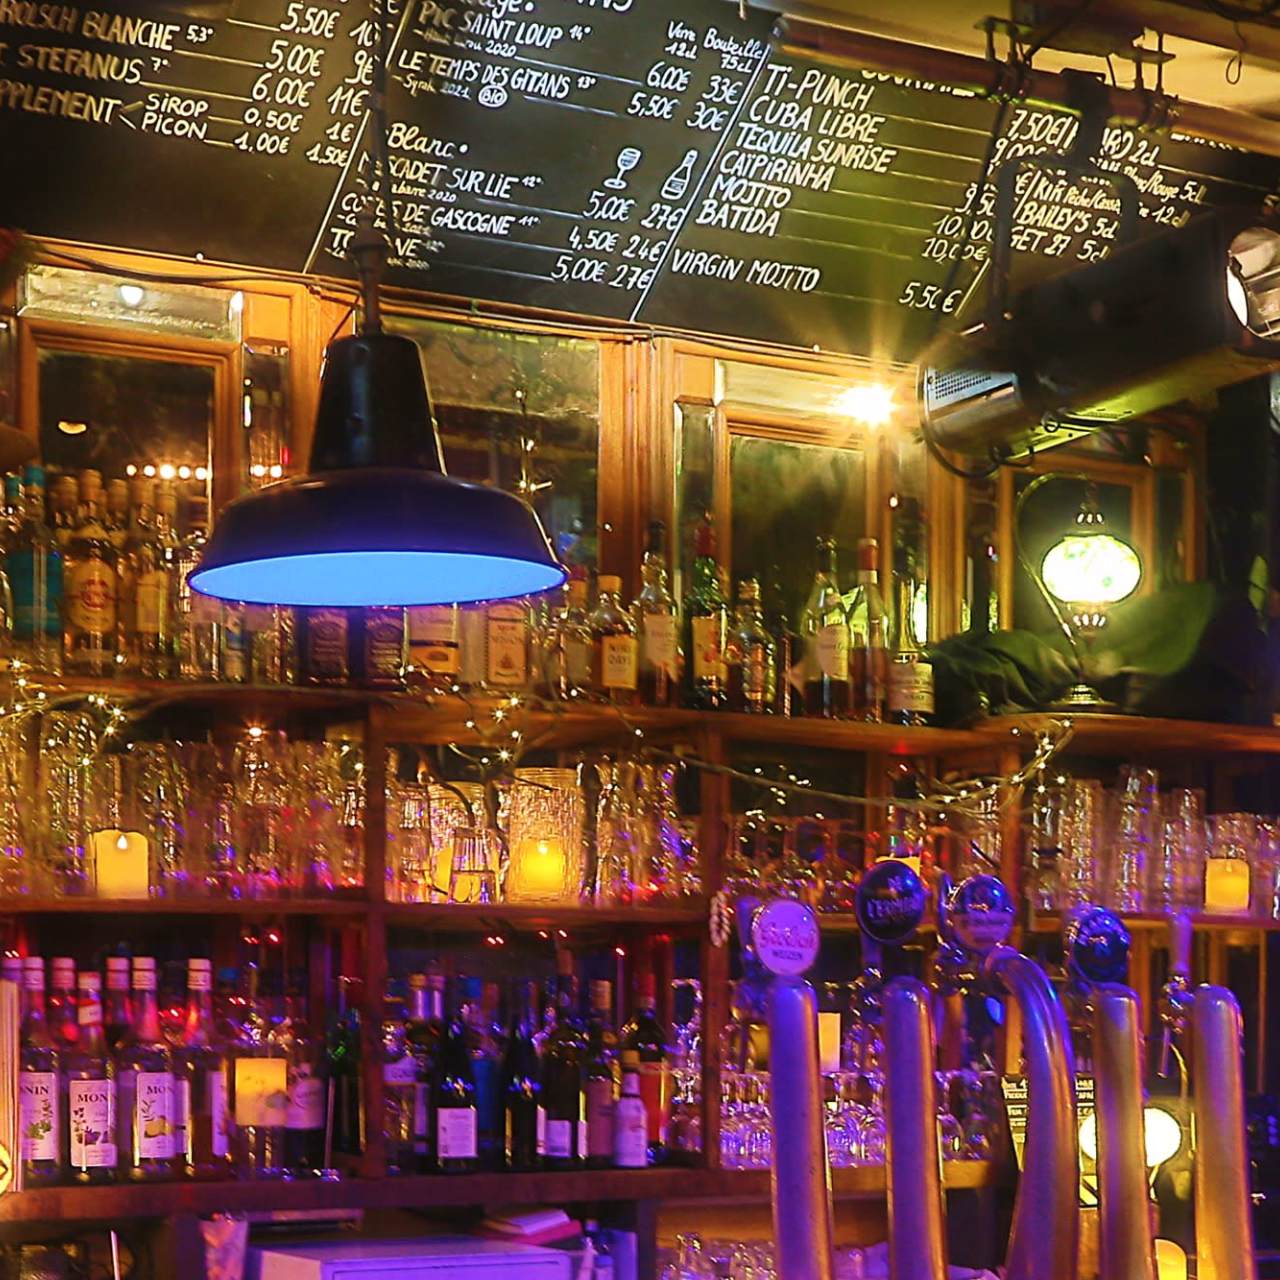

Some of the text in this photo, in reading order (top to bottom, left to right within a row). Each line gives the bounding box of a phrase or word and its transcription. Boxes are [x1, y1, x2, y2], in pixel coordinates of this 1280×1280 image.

[82, 9, 181, 51] BLANCHE
[19, 43, 145, 85] STEFANUS
[327, 85, 370, 117] 11€
[398, 49, 428, 71] LE
[428, 54, 481, 82] TEMPS
[480, 64, 510, 86] DES
[686, 101, 730, 132] 30€
[515, 22, 563, 49] LOUP
[701, 75, 743, 105] 33€
[326, 122, 354, 143] 1€
[749, 95, 815, 132] CUBA
[446, 167, 481, 197] SUR
[641, 203, 686, 230] 27€
[401, 203, 431, 224] DE
[430, 207, 517, 236] GASCOGNE
[622, 234, 667, 261] 24€
[608, 264, 654, 290] 27€
